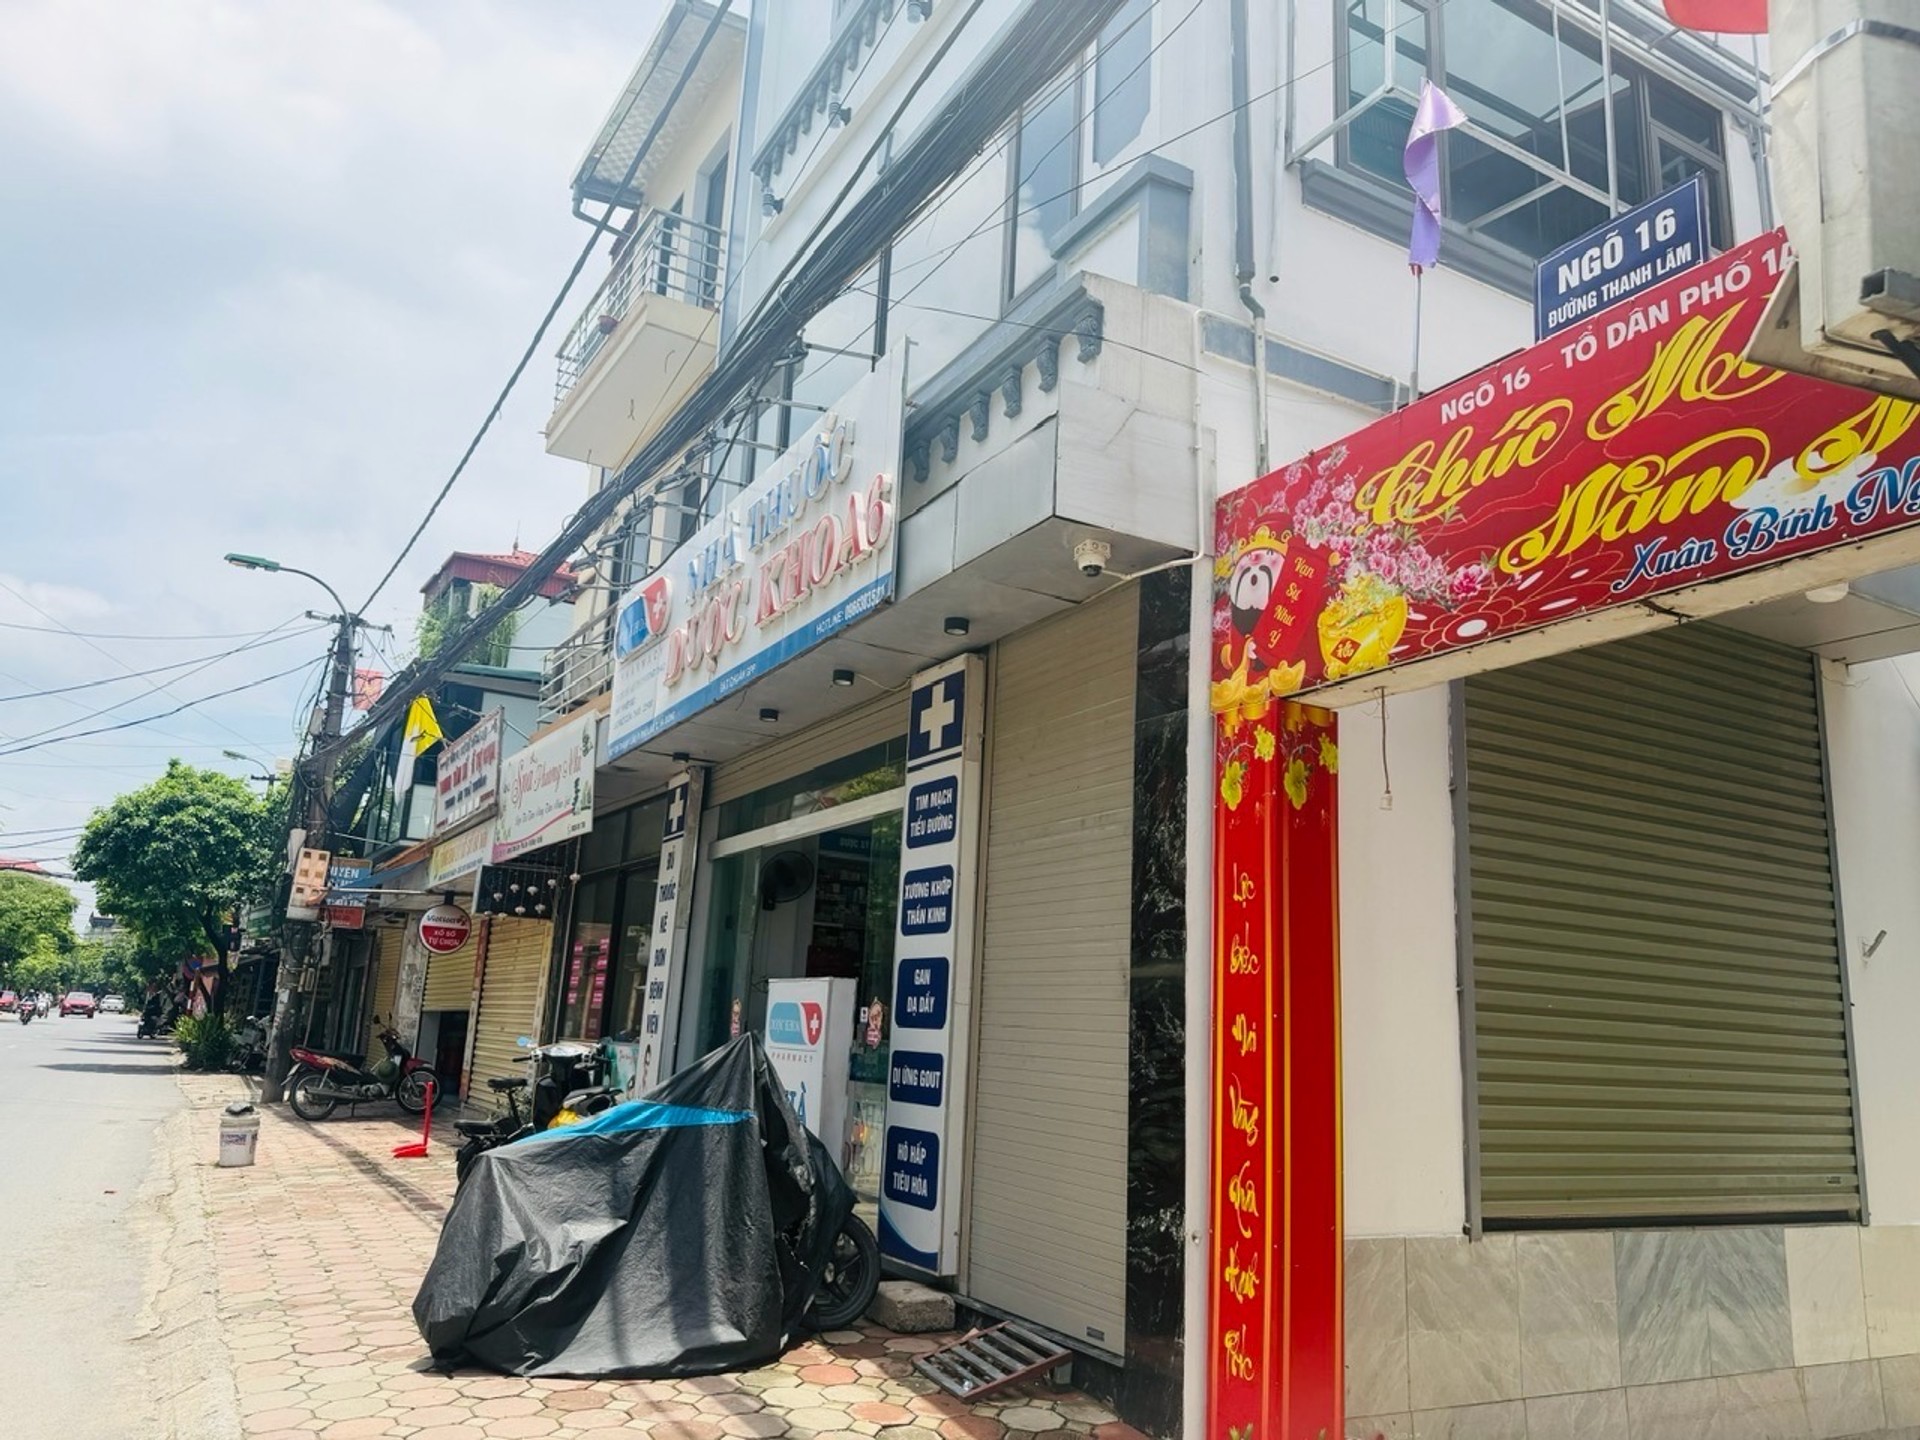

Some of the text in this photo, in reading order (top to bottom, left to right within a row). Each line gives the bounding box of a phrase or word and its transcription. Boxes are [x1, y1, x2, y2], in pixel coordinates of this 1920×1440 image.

[1558, 207, 1677, 295] NGÕ 16
[1547, 290, 1599, 329] ĐƯỜNG
[1601, 263, 1653, 302] THANH
[1440, 378, 1496, 425] NGÕ
[1501, 366, 1532, 397] 16
[1560, 324, 1599, 370] TỔ
[1606, 306, 1671, 351] DÂN
[1679, 249, 1753, 316] PHỐ
[1355, 398, 1574, 533] Chúc
[747, 412, 856, 554] THUỐC
[1499, 427, 1771, 574] Năm
[1613, 534, 1717, 594] Xuân
[1725, 493, 1837, 560] Bính
[1293, 555, 1316, 580] Vạn
[1284, 581, 1302, 604] Sự
[1273, 604, 1297, 628] Như
[663, 575, 751, 688] DƯỢC
[915, 787, 953, 812] TIM MẠCH
[927, 812, 954, 835] ĐƯỜNG
[904, 875, 952, 900] XƯƠNG KHỚP
[927, 906, 947, 924] KINH
[914, 968, 931, 986] GAN
[906, 995, 918, 1017] DẠ
[770, 1052, 814, 1064] PHARMACY
[892, 1066, 901, 1088] DỊ
[919, 1069, 941, 1090] GOUT
[909, 1139, 927, 1166] HẤP
[911, 1173, 928, 1198] HÓA
